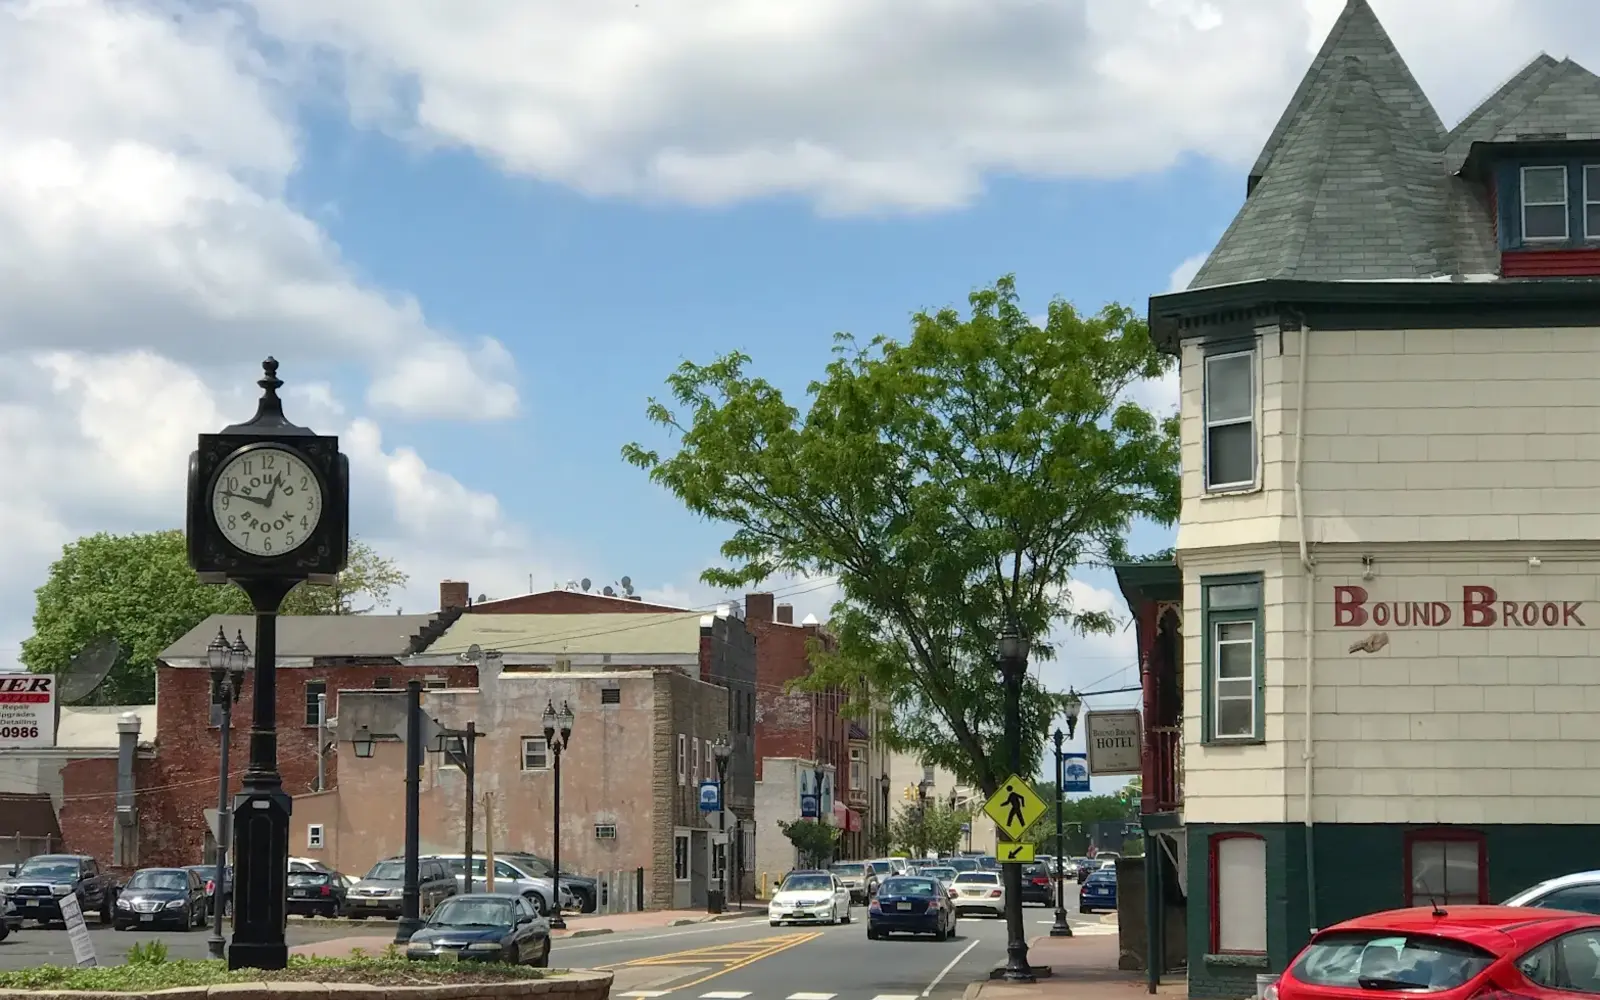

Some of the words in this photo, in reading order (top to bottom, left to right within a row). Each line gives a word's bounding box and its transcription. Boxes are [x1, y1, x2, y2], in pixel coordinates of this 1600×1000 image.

[243, 461, 252, 475] 11
[262, 455, 274, 470] 12
[286, 461, 292, 476] 1
[226, 477, 238, 492] 10
[241, 474, 294, 496] BOUND
[301, 476, 308, 491] 2
[222, 496, 229, 511] 9
[307, 496, 314, 511] 3
[227, 515, 236, 530] 8
[240, 510, 295, 533] BROOK
[300, 515, 308, 530] 4
[241, 532, 250, 546] 7
[263, 536, 272, 551] 6
[285, 530, 294, 546] 5
[1333, 585, 1452, 627] BOUND
[1462, 585, 1586, 627] BROOK
[1092, 729, 1115, 737] BOUND
[1115, 728, 1136, 736] BROOK
[1096, 737, 1135, 748] HOTEL
